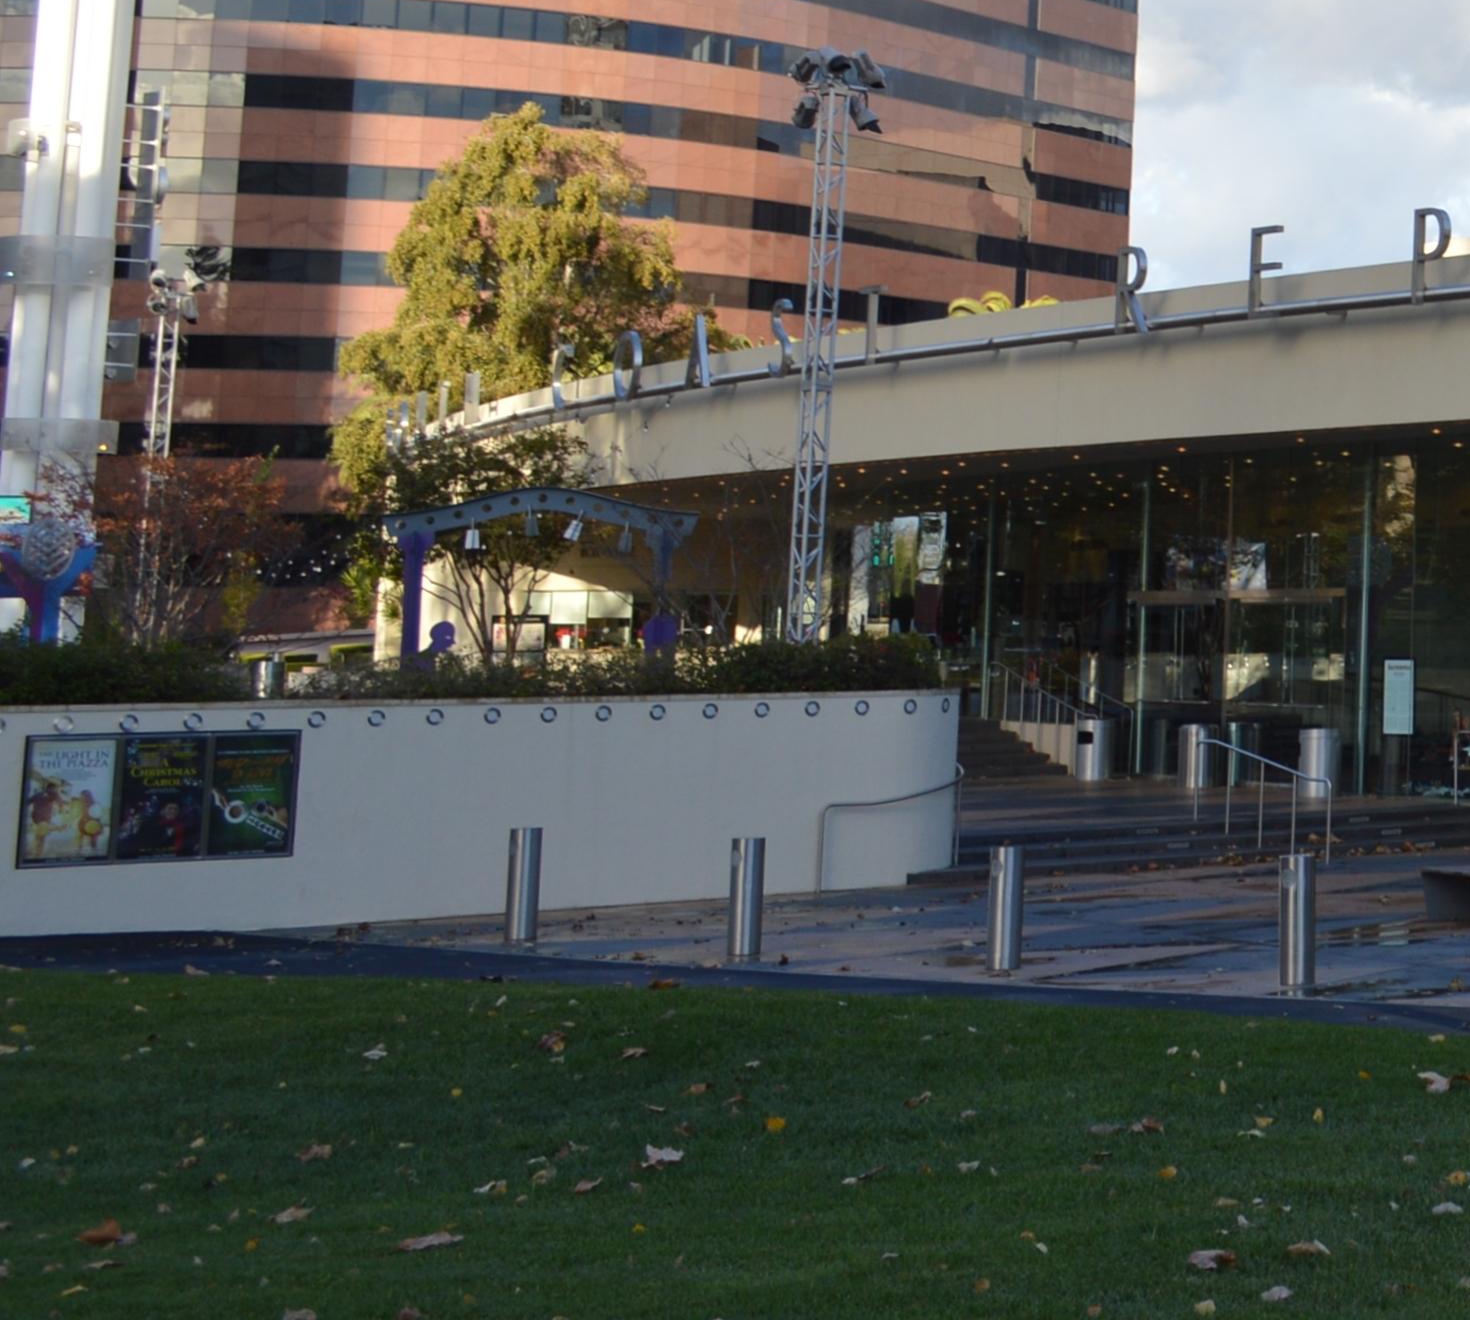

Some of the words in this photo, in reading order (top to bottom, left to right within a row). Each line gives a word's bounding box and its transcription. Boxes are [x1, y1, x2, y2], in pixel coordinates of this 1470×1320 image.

[552, 285, 888, 409] COAST
[55, 750, 92, 759] LIGHT
[96, 749, 110, 758] IN
[67, 759, 109, 768] PIAZZA
